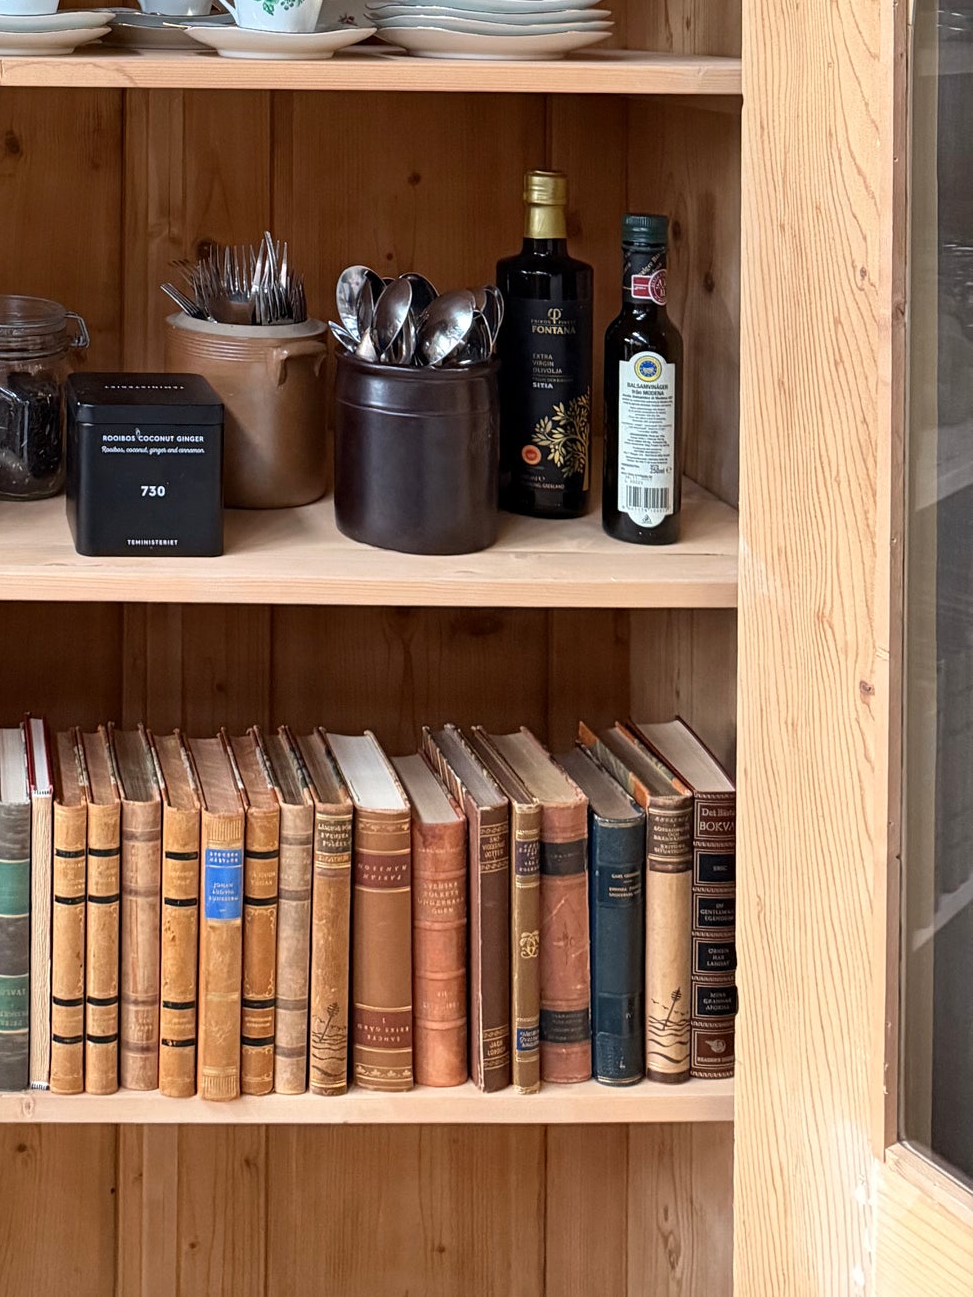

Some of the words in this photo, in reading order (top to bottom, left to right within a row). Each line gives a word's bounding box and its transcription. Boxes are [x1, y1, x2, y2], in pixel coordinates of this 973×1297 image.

[531, 326, 576, 334] FONTANA
[141, 486, 165, 497] 730
[701, 808, 716, 817] Det
